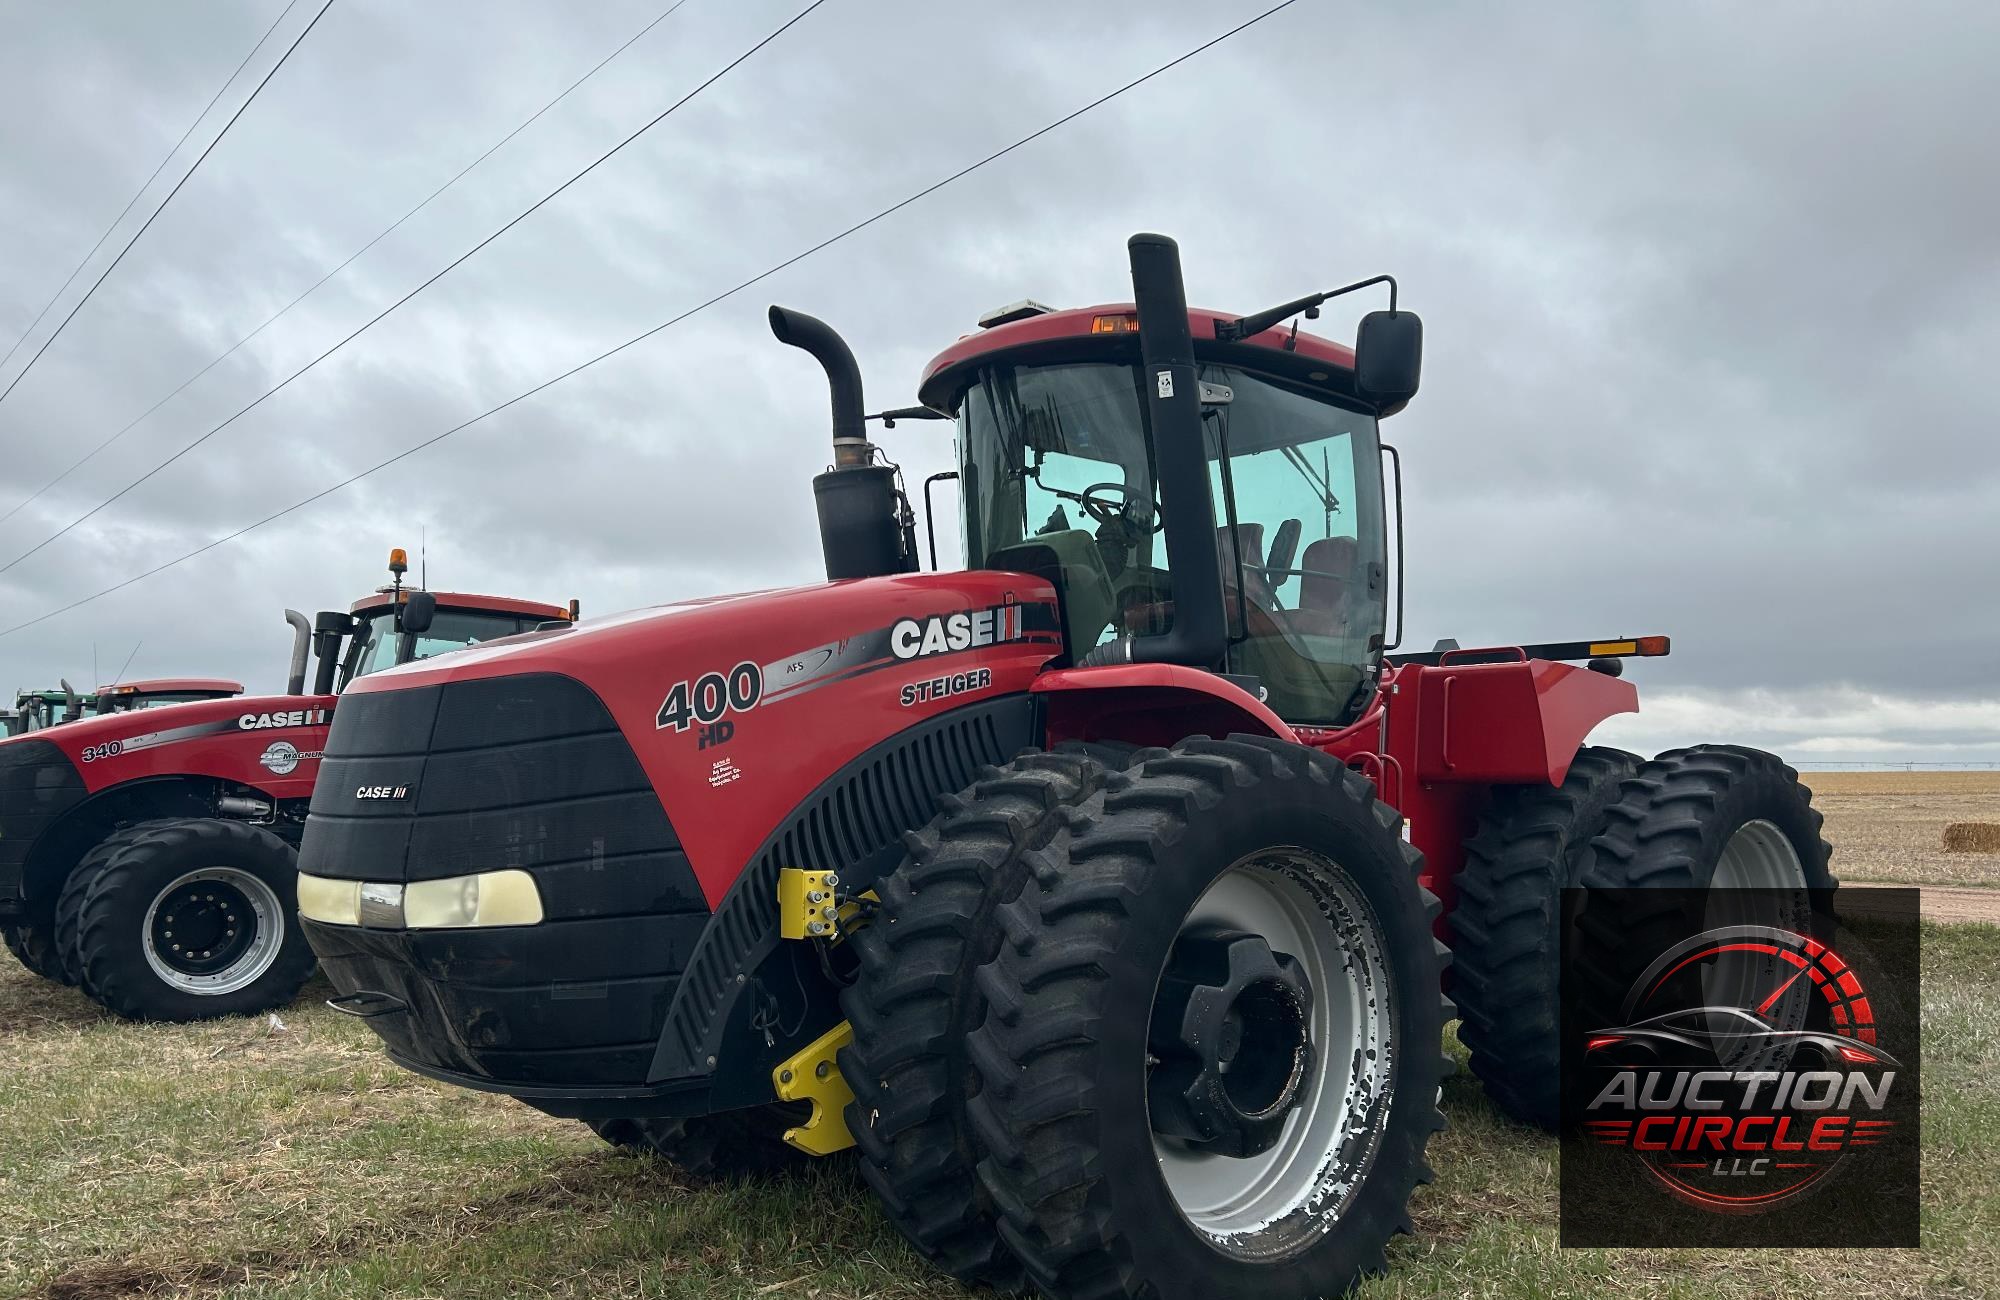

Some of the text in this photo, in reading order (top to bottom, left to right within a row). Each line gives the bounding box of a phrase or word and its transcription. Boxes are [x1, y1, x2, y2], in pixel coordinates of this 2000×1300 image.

[890, 610, 993, 660] CASE
[786, 661, 804, 674] AFS
[656, 660, 763, 733] 400
[900, 667, 992, 706] STEIGER
[238, 710, 304, 730] CASE
[698, 721, 735, 751] HD
[82, 740, 122, 763] 340
[356, 786, 392, 799] CASE
